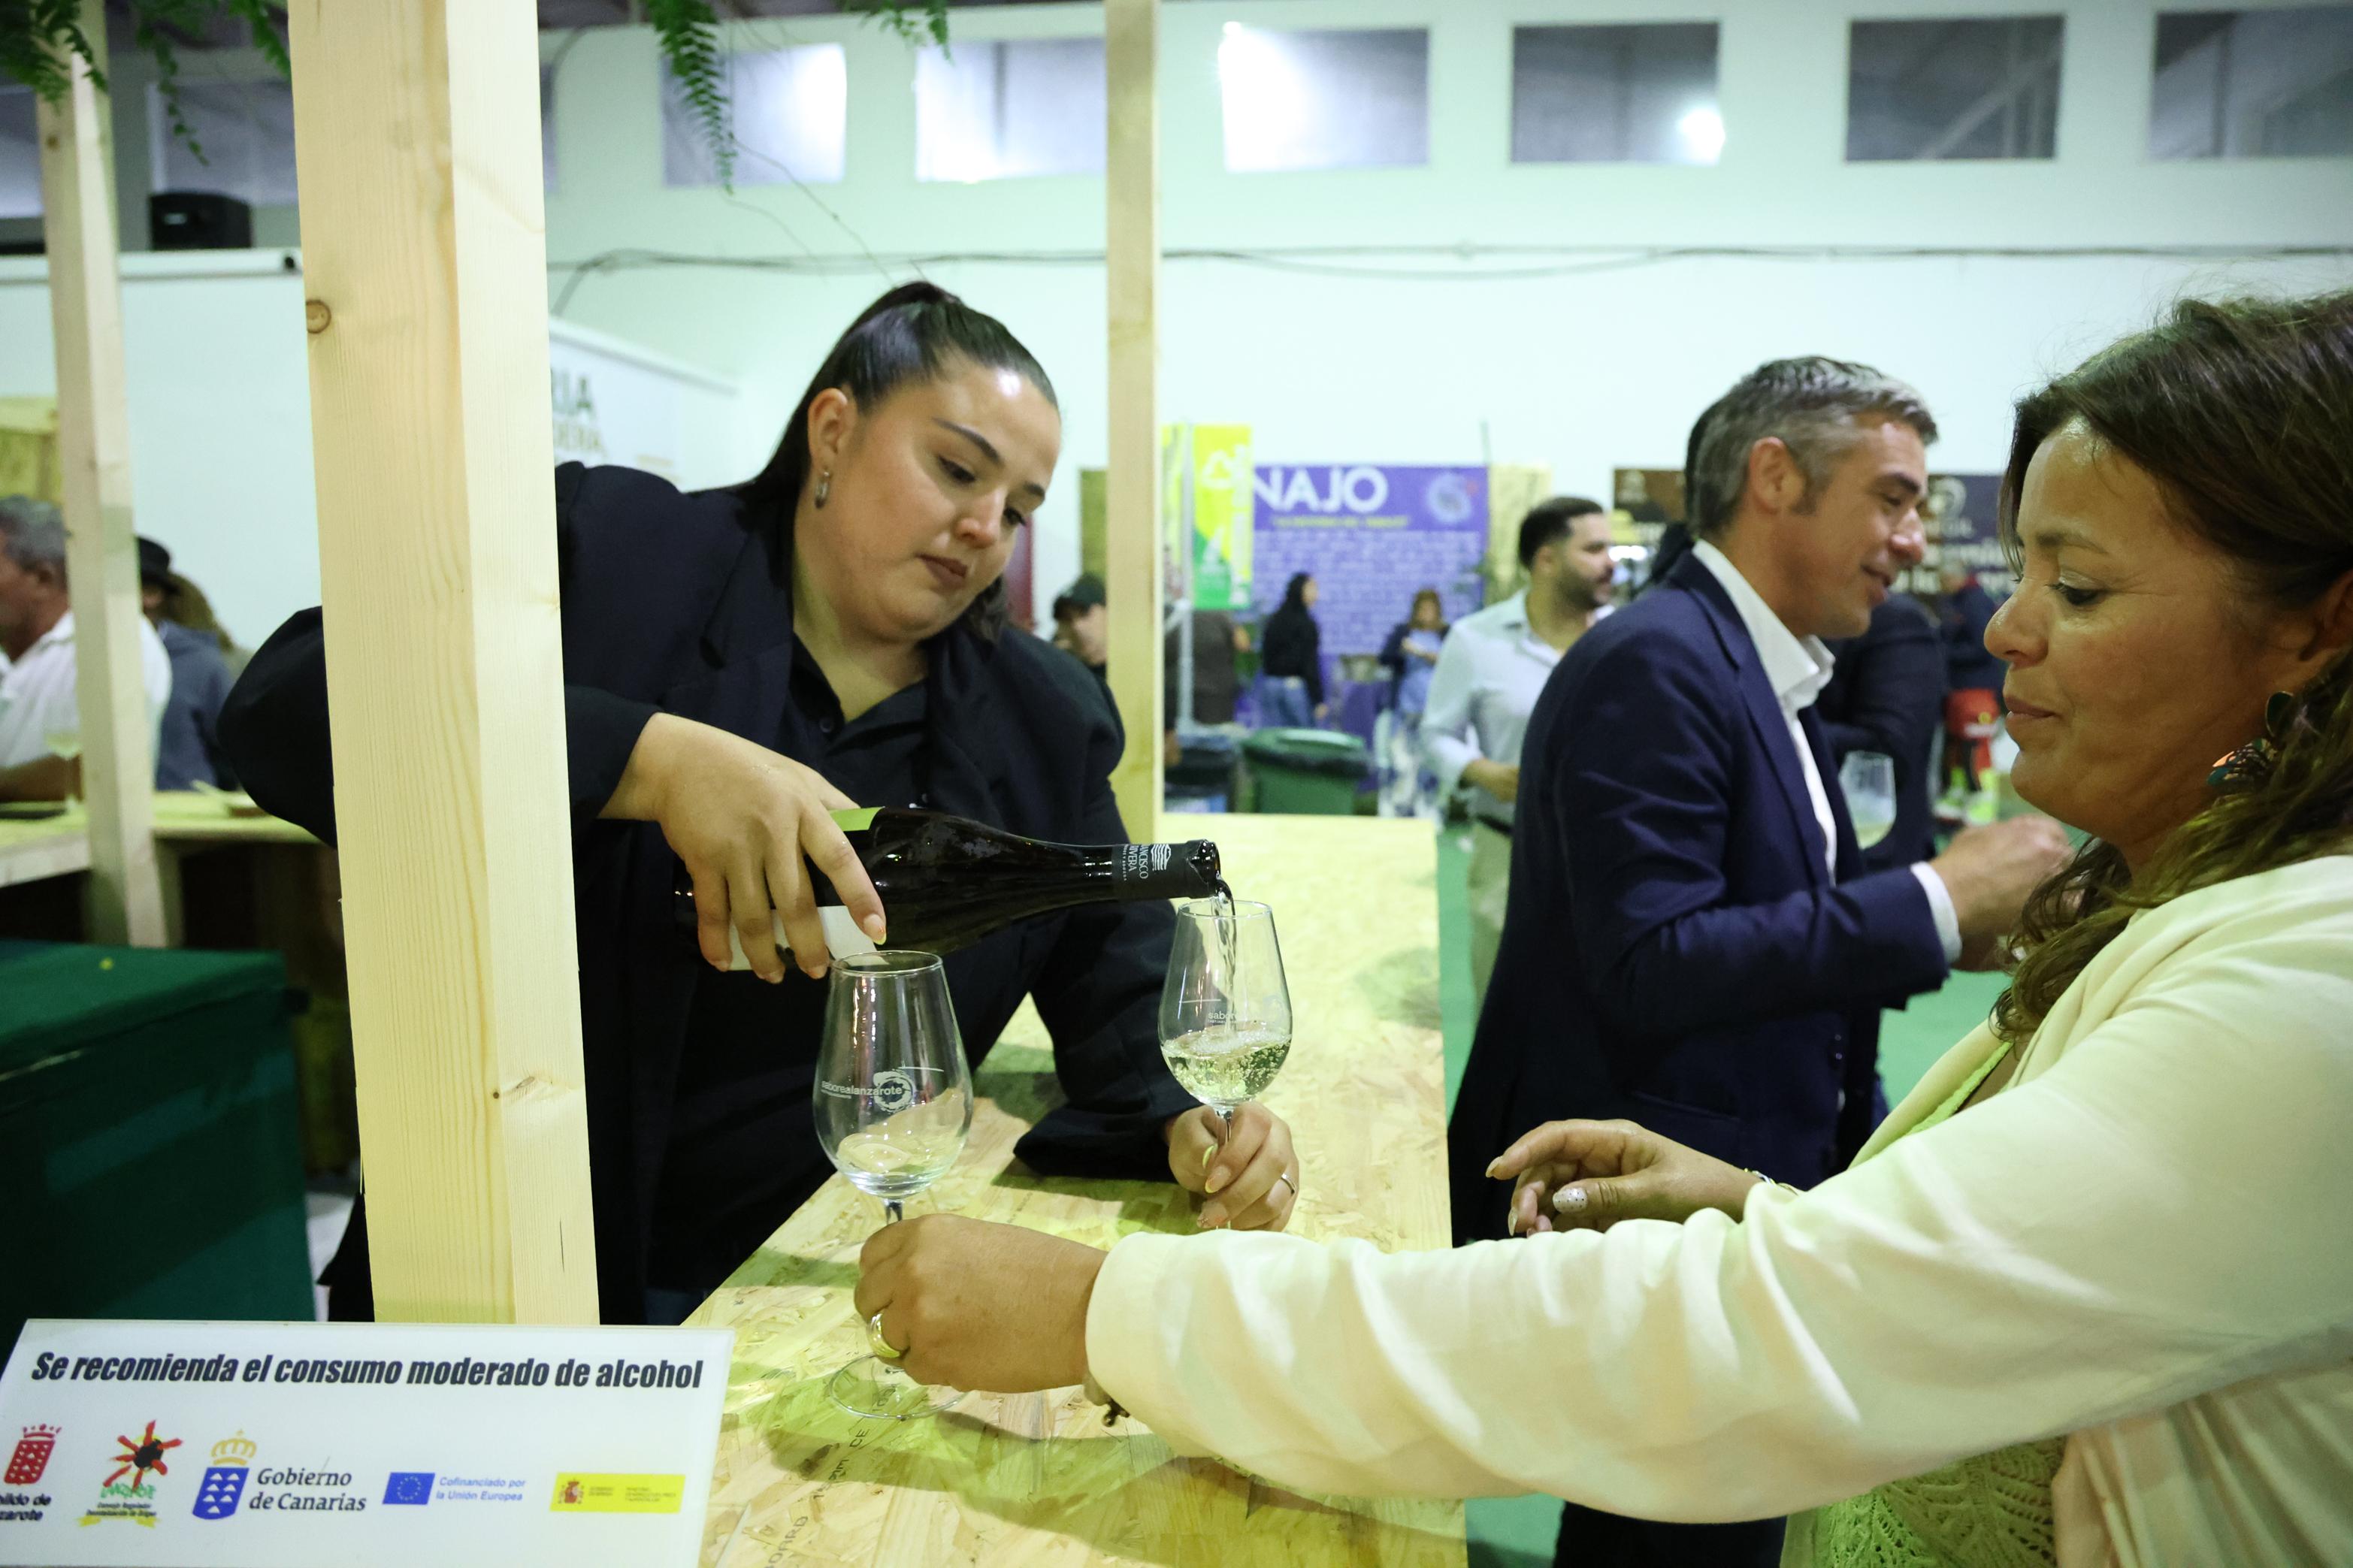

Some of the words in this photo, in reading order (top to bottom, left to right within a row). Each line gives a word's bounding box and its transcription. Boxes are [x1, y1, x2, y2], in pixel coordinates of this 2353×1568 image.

[1138, 844, 1149, 879] ANCISCO
[31, 1351, 69, 1381] Se
[70, 1353, 239, 1382] recomienda
[241, 1355, 274, 1382] el
[274, 1358, 404, 1384] consumo
[406, 1357, 549, 1386] moderado
[554, 1358, 591, 1387] de
[595, 1359, 703, 1388] alcohol
[256, 1467, 352, 1485] Gobierno
[439, 1476, 506, 1487] Cofinanciado
[509, 1479, 526, 1488] por
[249, 1491, 274, 1510] de
[277, 1493, 367, 1512] Canarias
[436, 1491, 445, 1500] la
[448, 1491, 477, 1500] Unión
[480, 1491, 523, 1502] Europea
